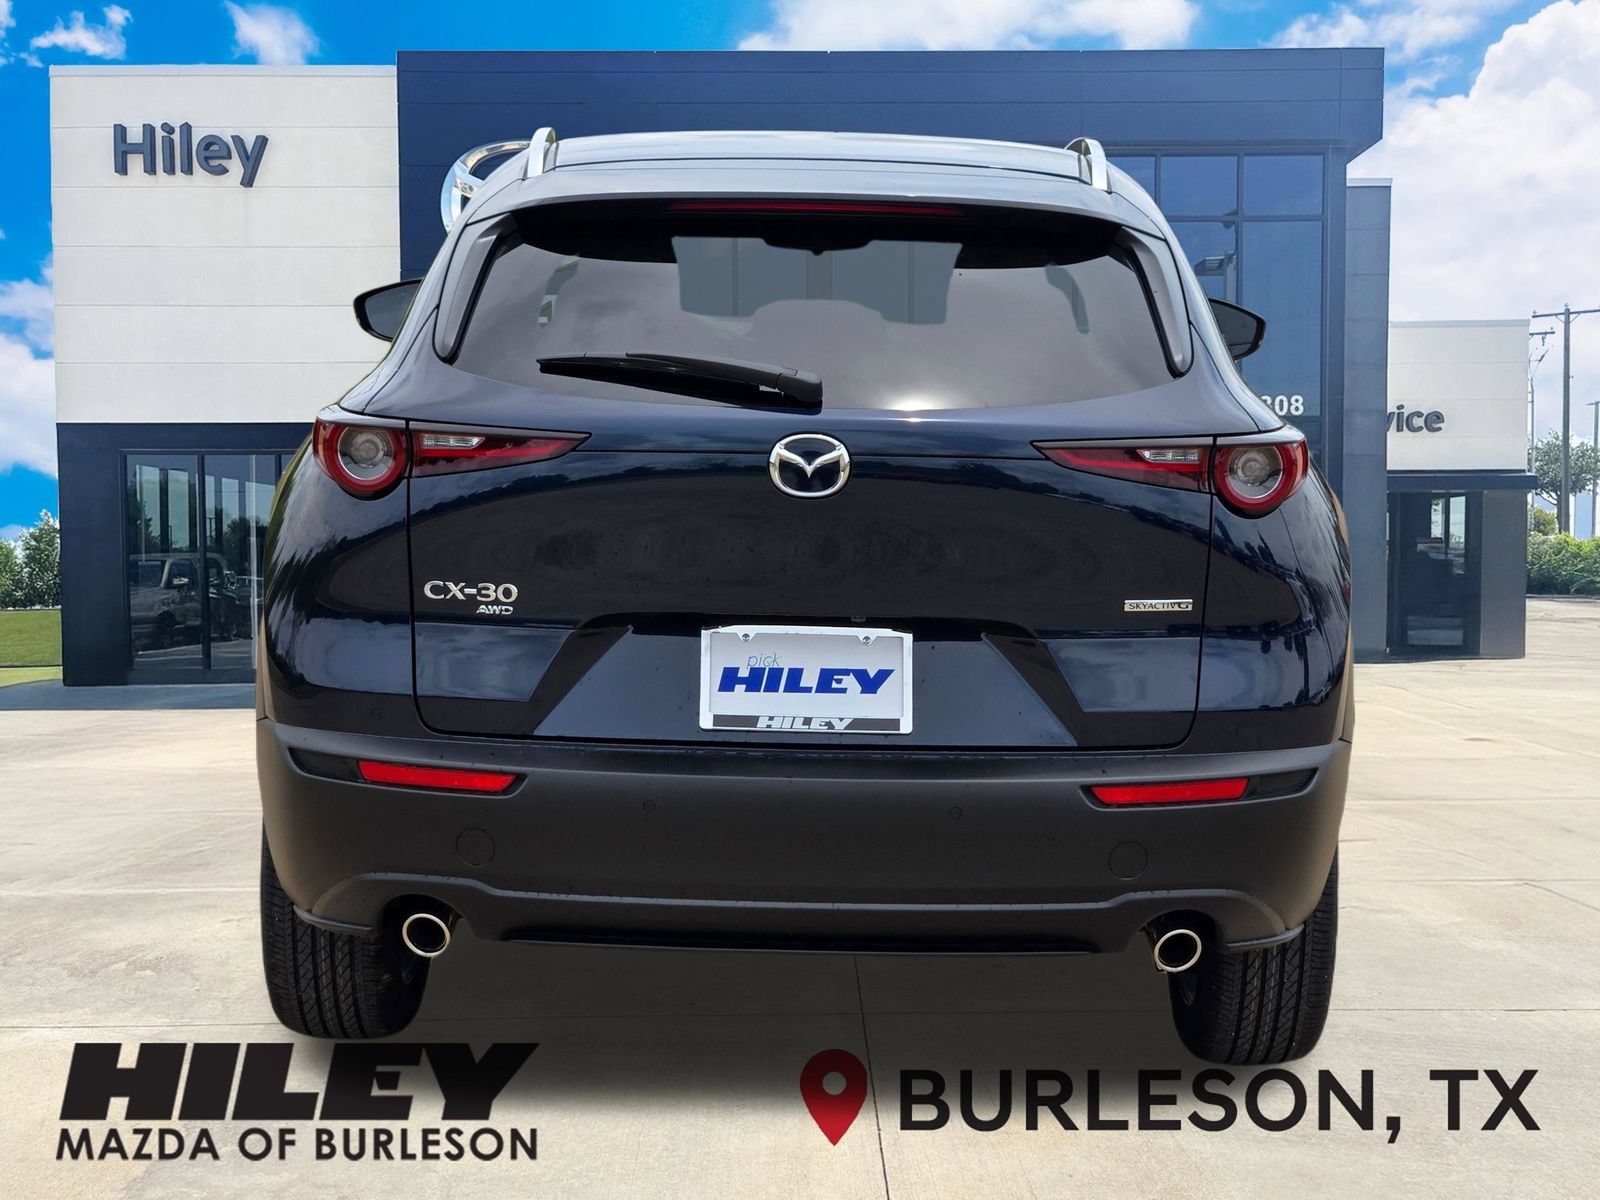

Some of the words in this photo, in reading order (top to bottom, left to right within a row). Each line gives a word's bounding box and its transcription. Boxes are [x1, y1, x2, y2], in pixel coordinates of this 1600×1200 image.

[113, 121, 269, 188] Hiley
[423, 580, 519, 603] CX-30
[475, 604, 514, 615] AWD
[746, 653, 780, 669] pick
[717, 666, 896, 695] HILEY
[756, 716, 854, 730] HILEY
